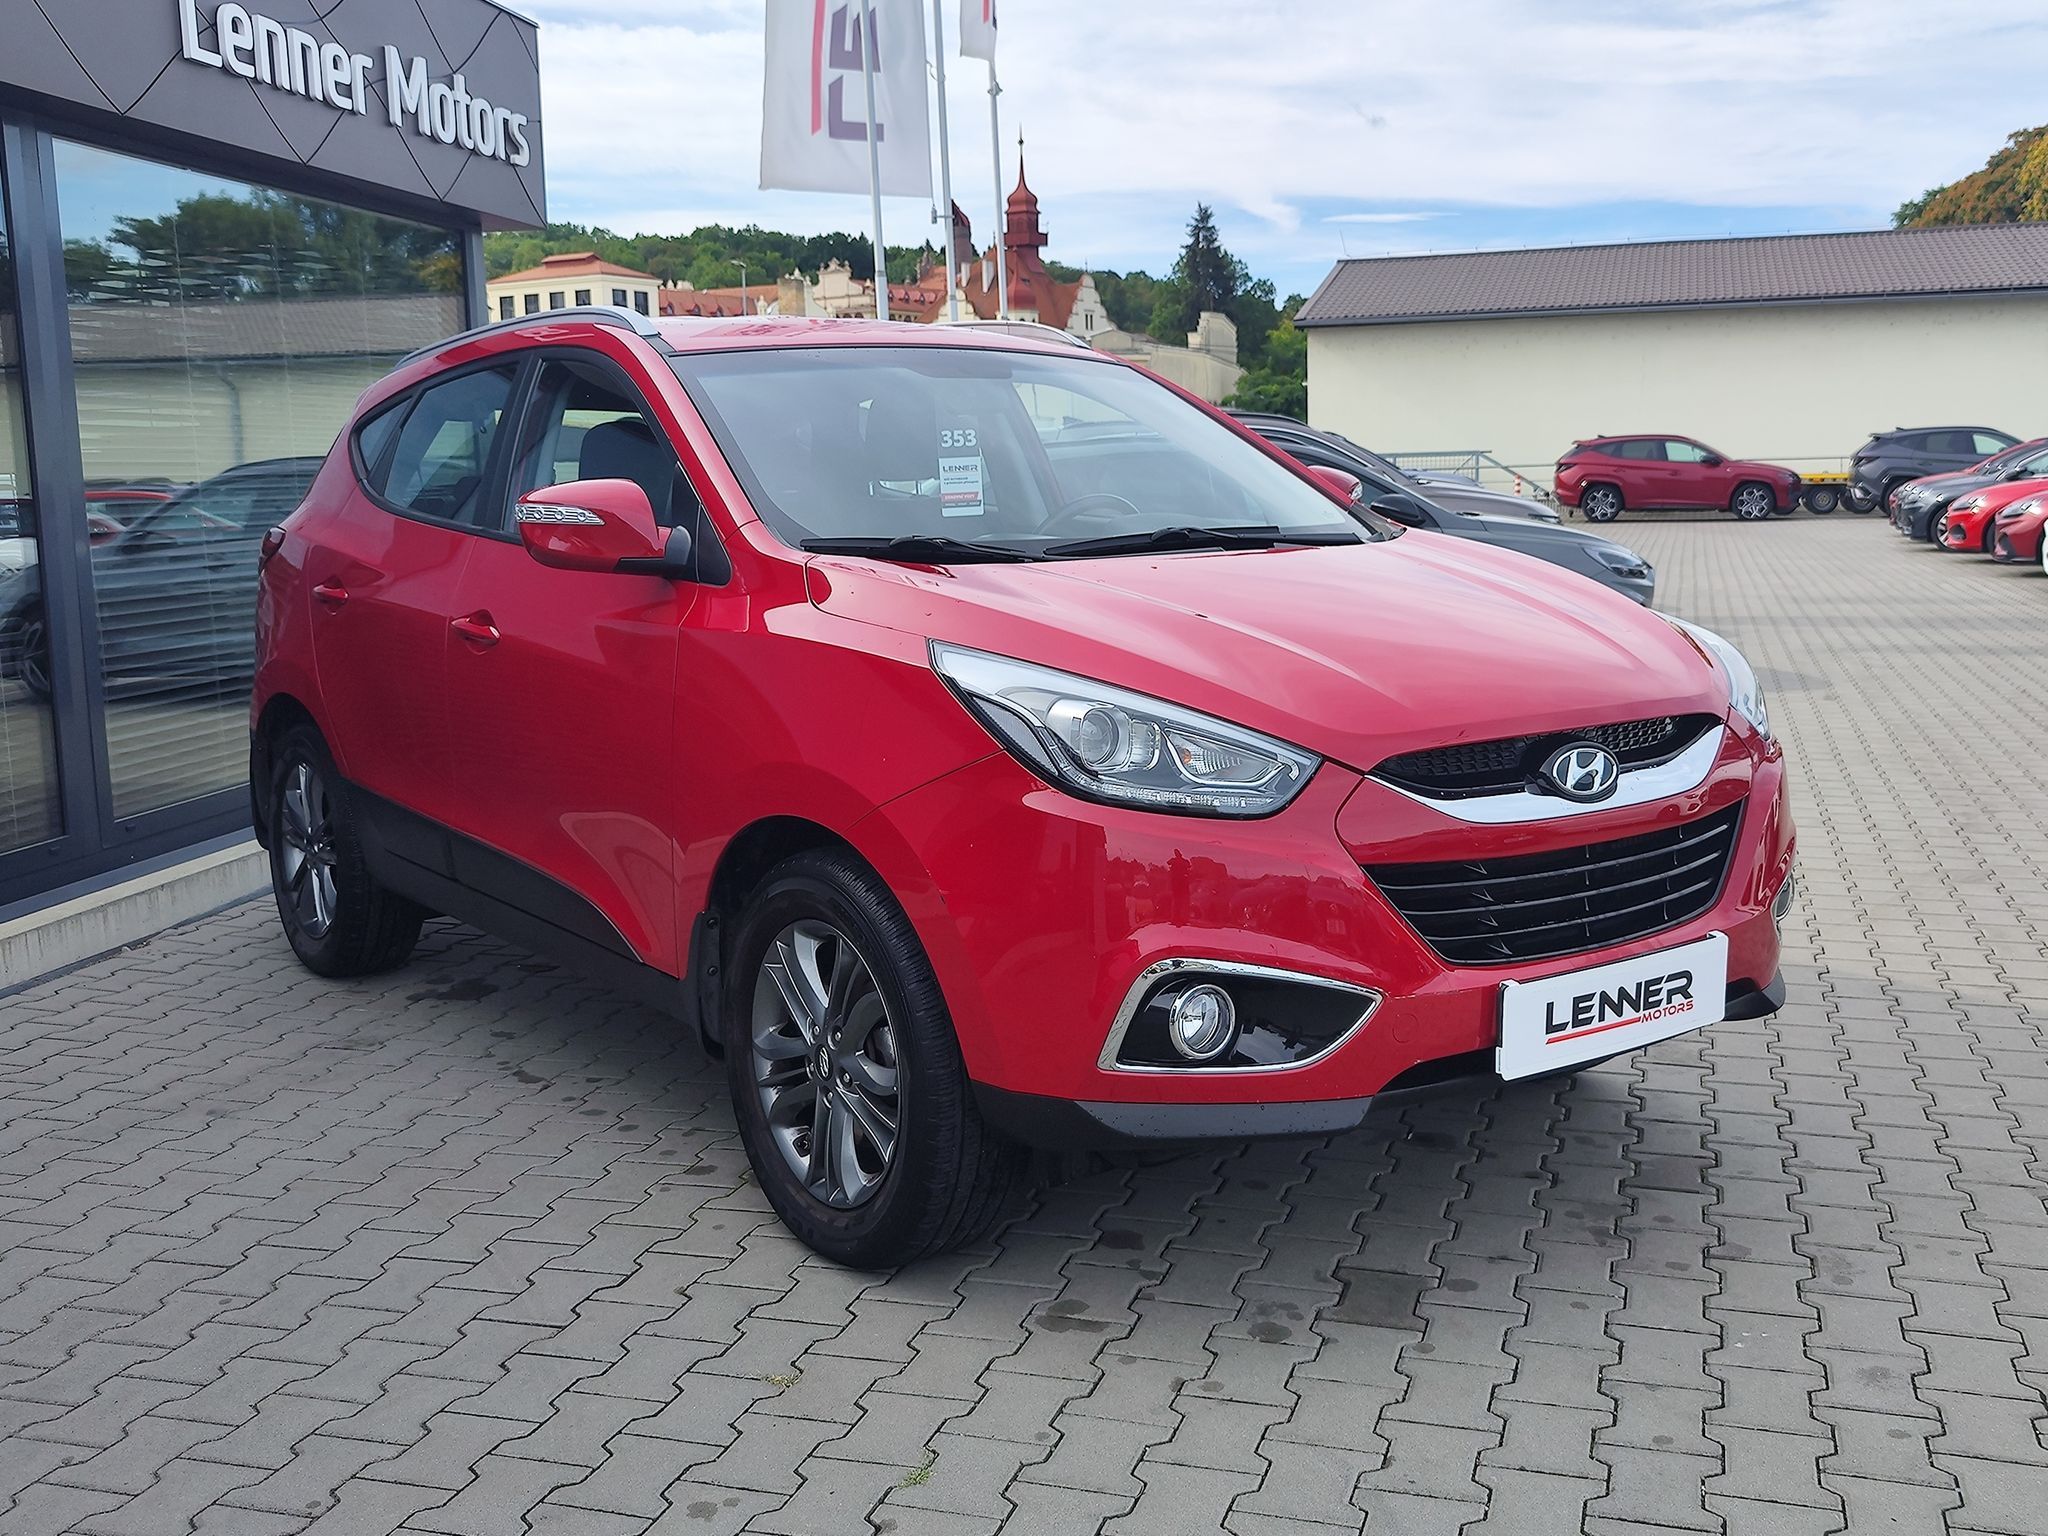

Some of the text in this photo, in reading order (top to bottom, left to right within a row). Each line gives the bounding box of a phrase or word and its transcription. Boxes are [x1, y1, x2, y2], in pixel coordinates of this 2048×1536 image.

[179, 0, 531, 168] Lenner Motors
[941, 429, 977, 448] 353
[1545, 970, 1693, 1035] LENNER
[1641, 1000, 1694, 1023] MOTORS
